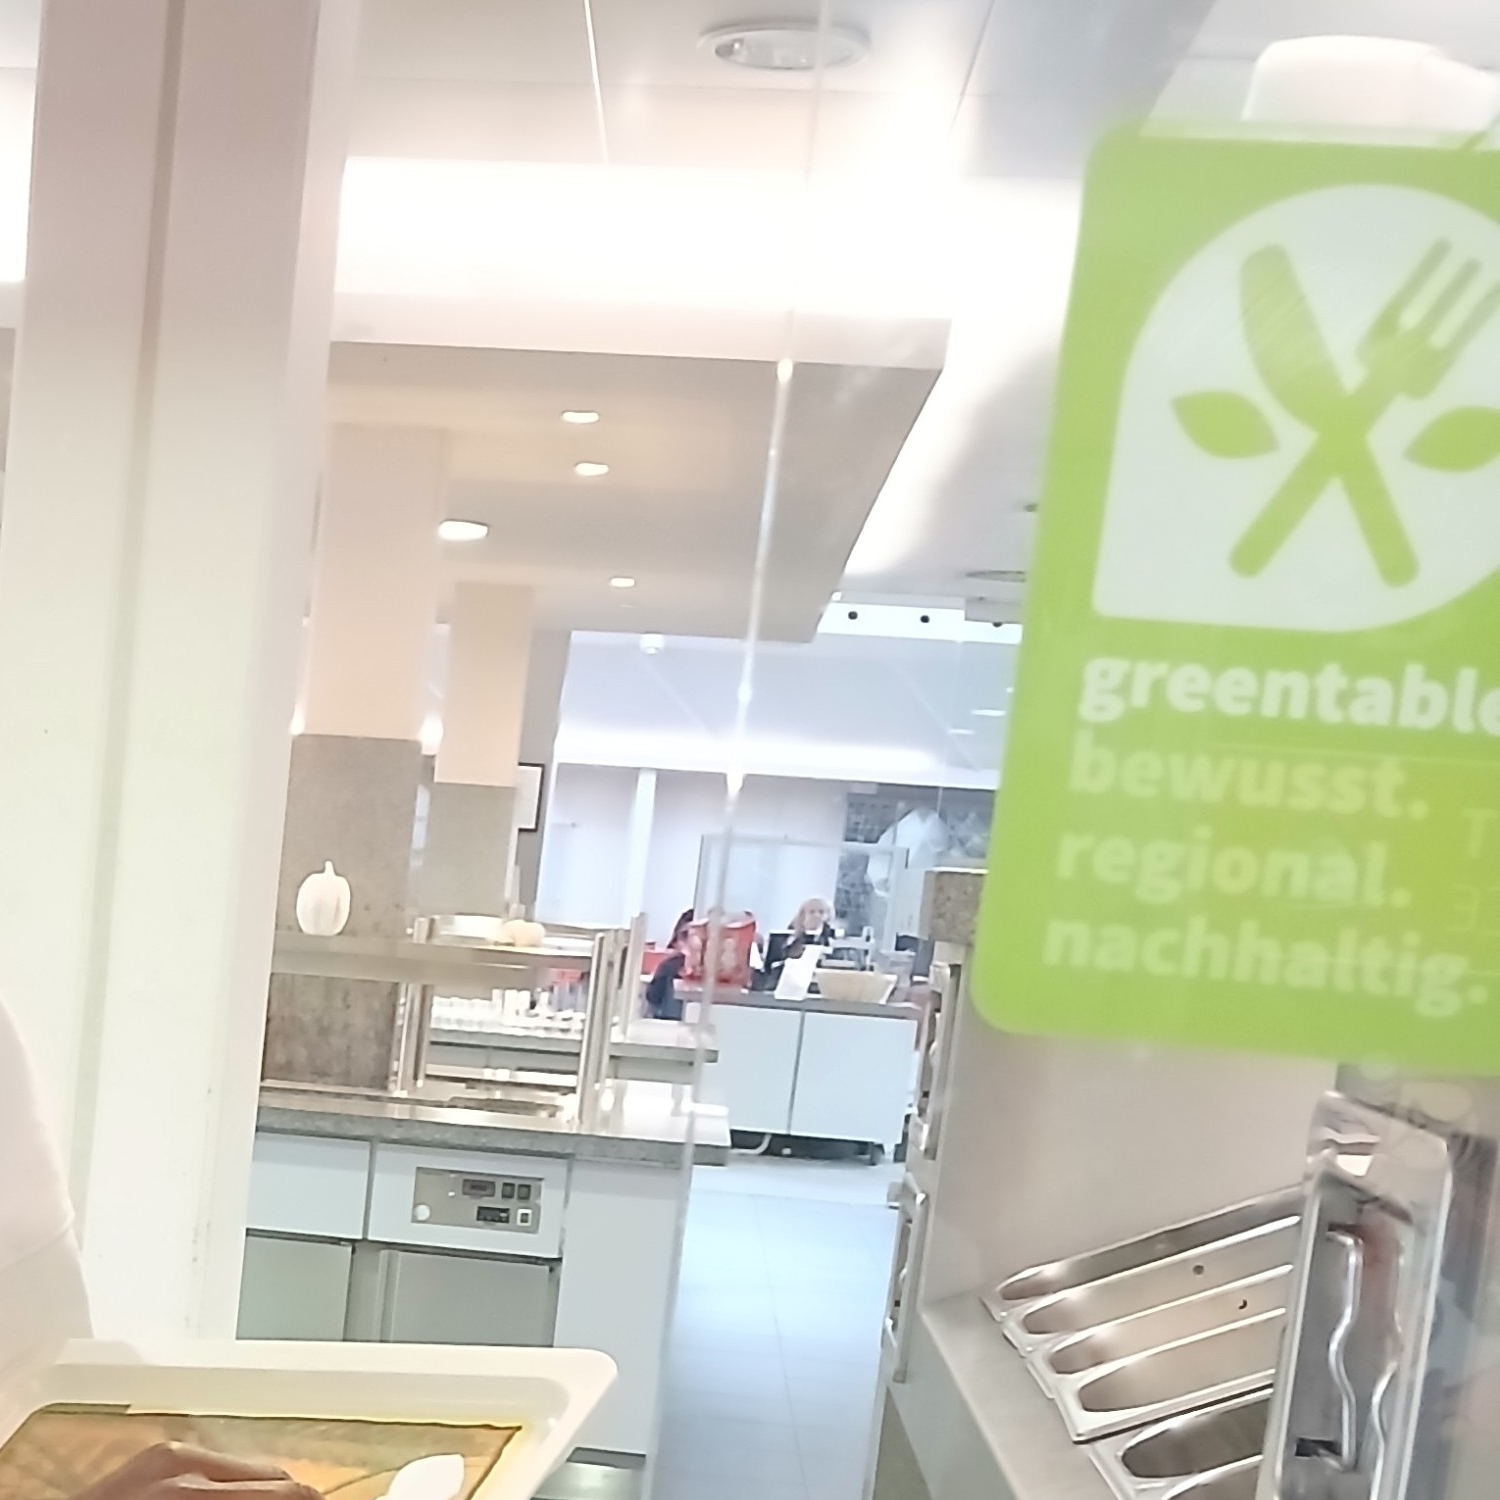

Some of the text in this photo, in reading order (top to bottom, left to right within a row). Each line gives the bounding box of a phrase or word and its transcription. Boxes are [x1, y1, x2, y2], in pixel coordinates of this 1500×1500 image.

[1071, 730, 1428, 820] bewusst.
[1056, 826, 1412, 904] regional.
[1043, 914, 1489, 1019] nachhaltig.
